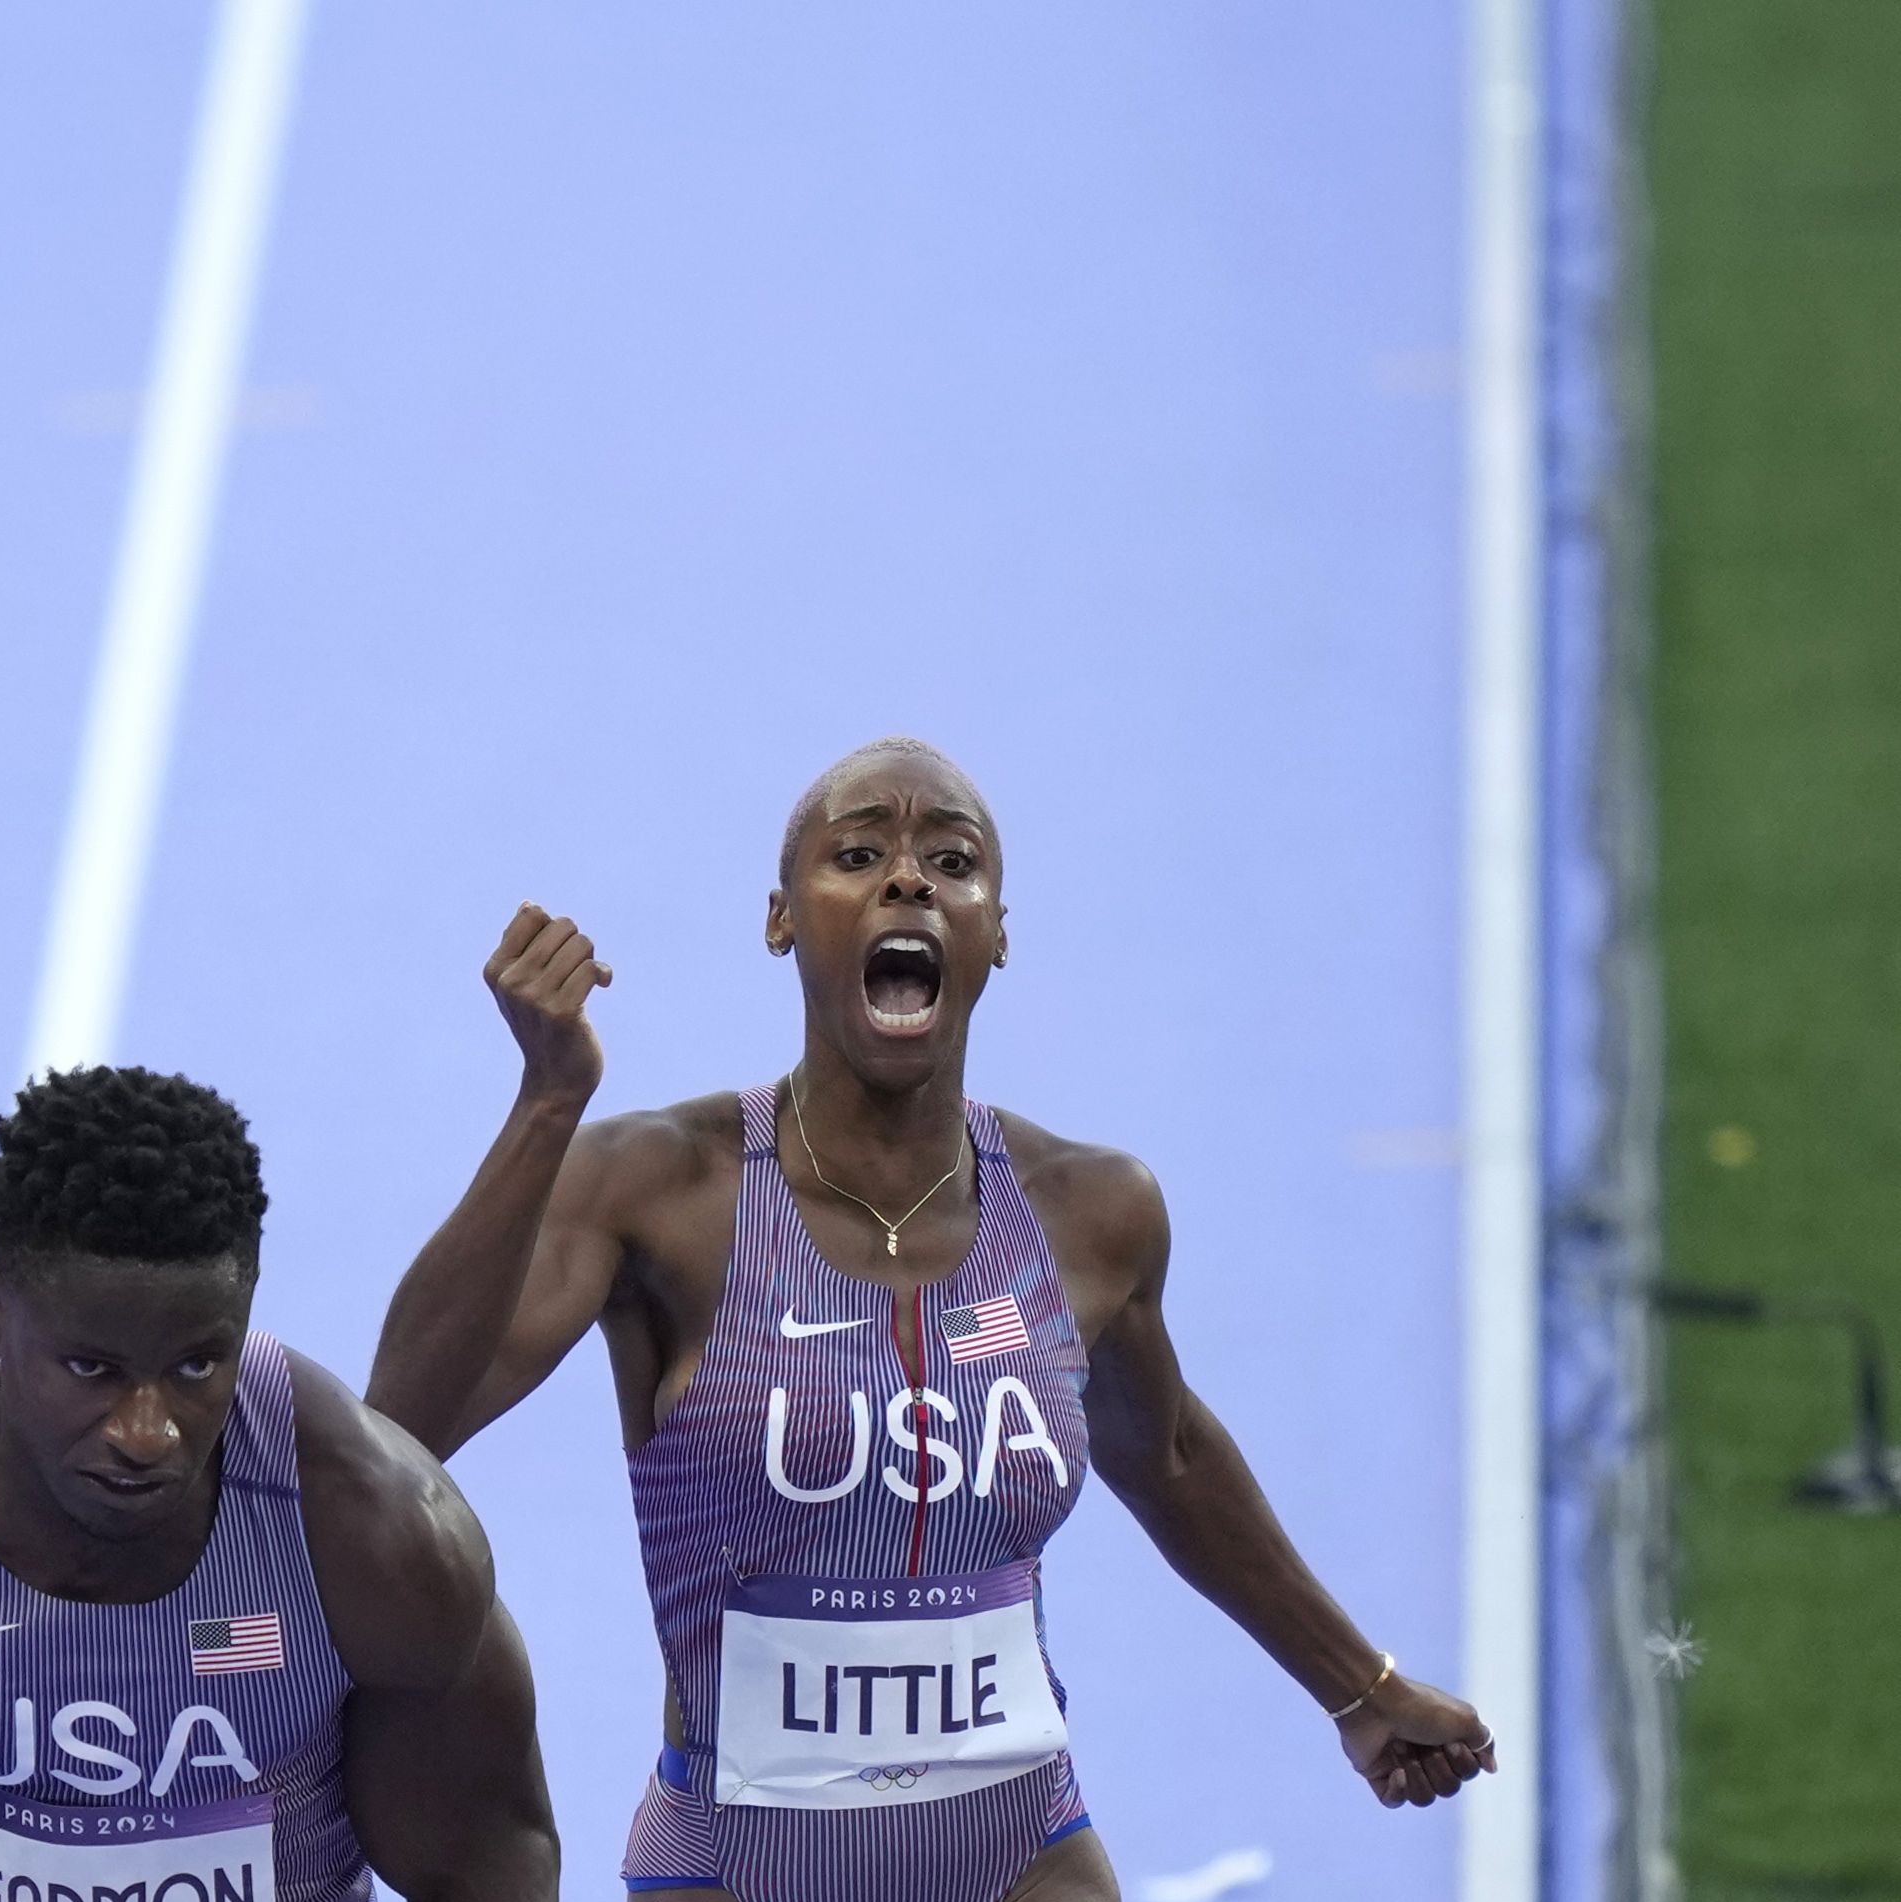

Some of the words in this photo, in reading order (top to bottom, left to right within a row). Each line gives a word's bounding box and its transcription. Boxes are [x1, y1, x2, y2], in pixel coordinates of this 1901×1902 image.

[765, 1376, 1068, 1504] USA
[811, 1587, 896, 1609] PARIS
[907, 1585, 978, 1608] 2024
[782, 1653, 1007, 1736] LITTLE
[4, 1803, 85, 1835] PARIS
[96, 1812, 176, 1836] 2024
